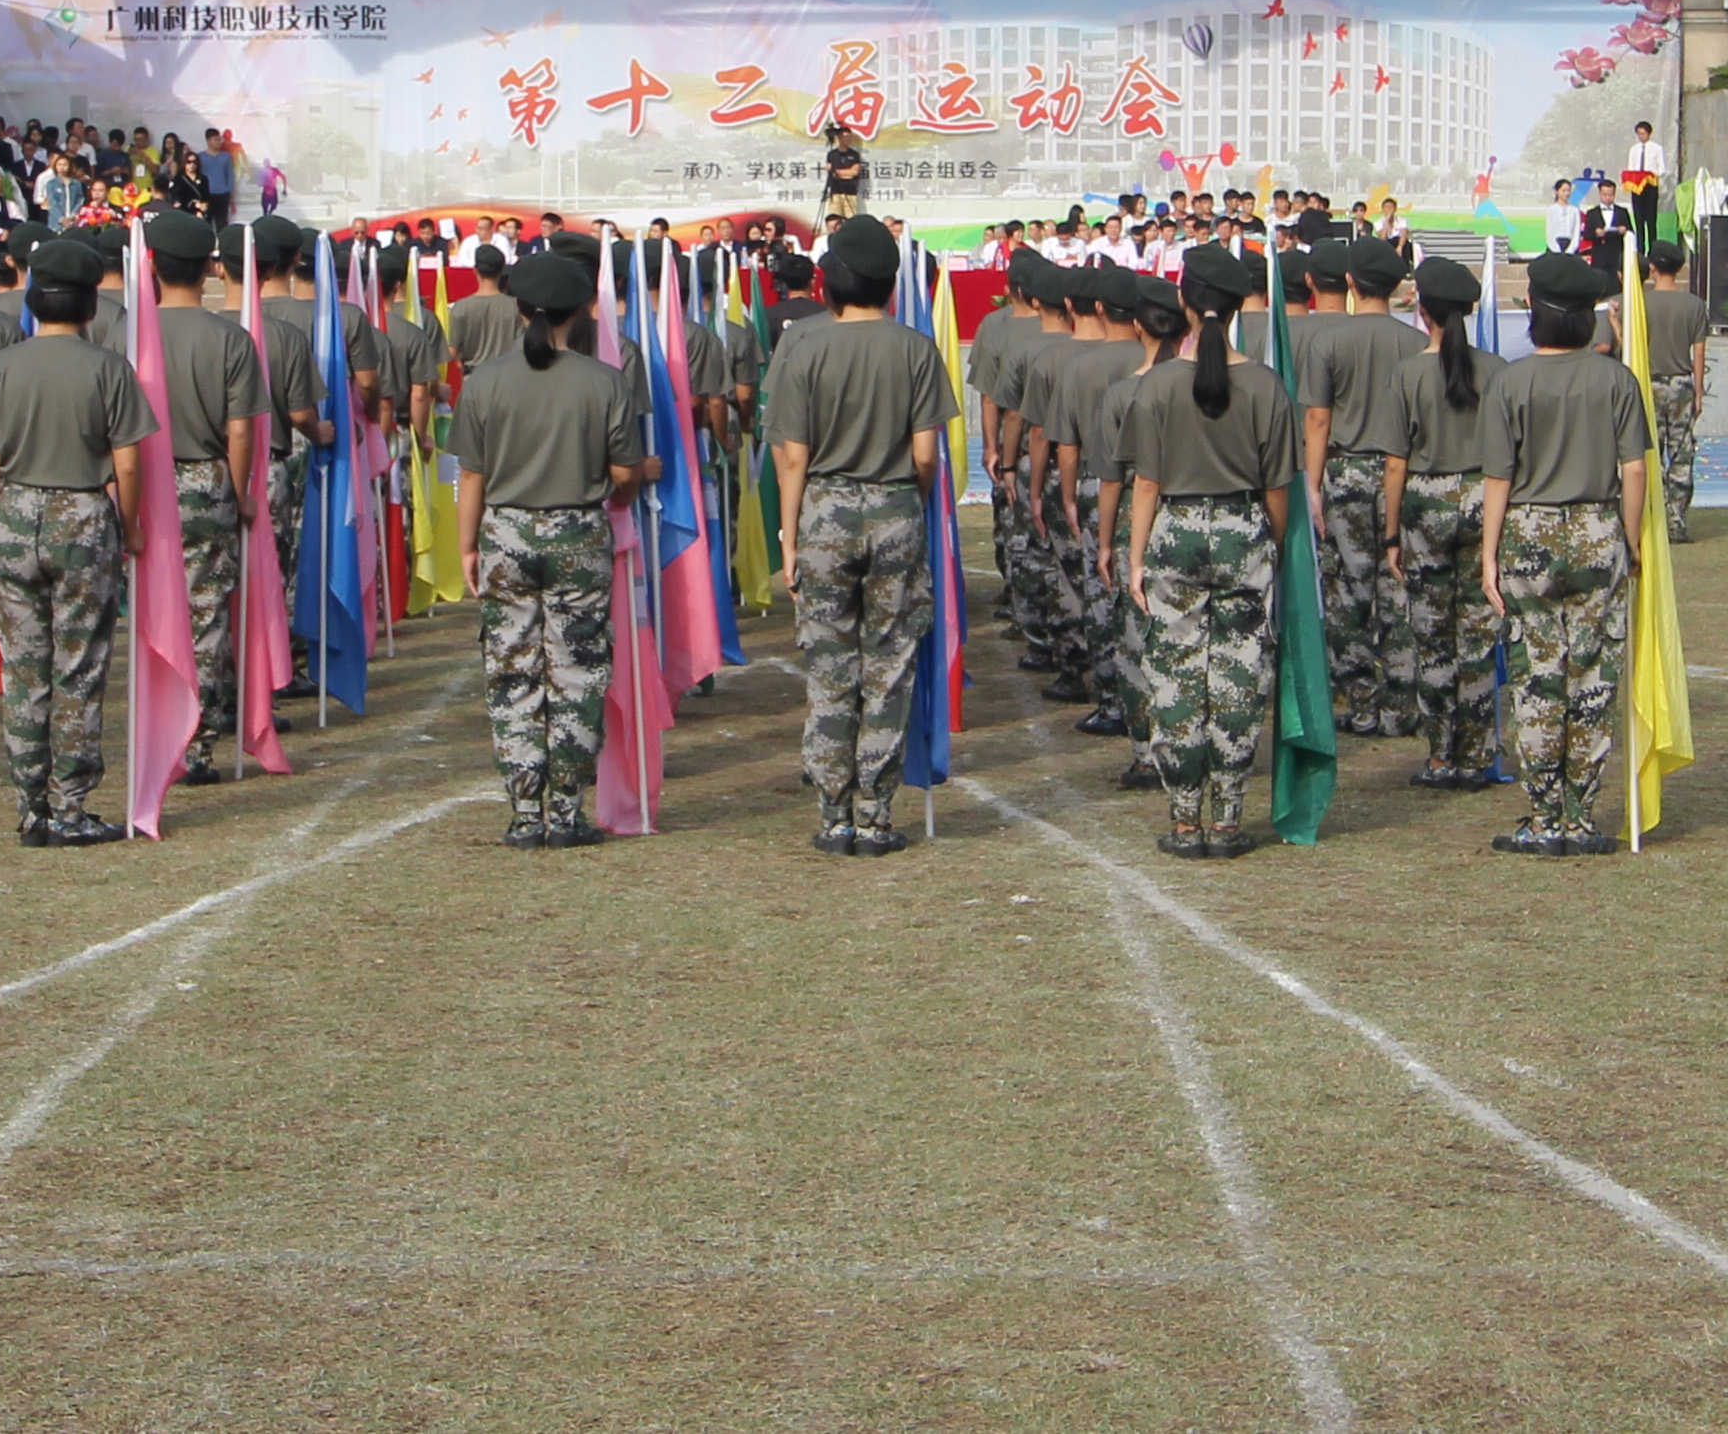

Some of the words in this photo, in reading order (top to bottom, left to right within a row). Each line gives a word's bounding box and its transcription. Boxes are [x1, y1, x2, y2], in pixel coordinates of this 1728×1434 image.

[107, 5, 387, 31] 广州科技职业技术学院
[499, 41, 1182, 147] 第十二届运动会
